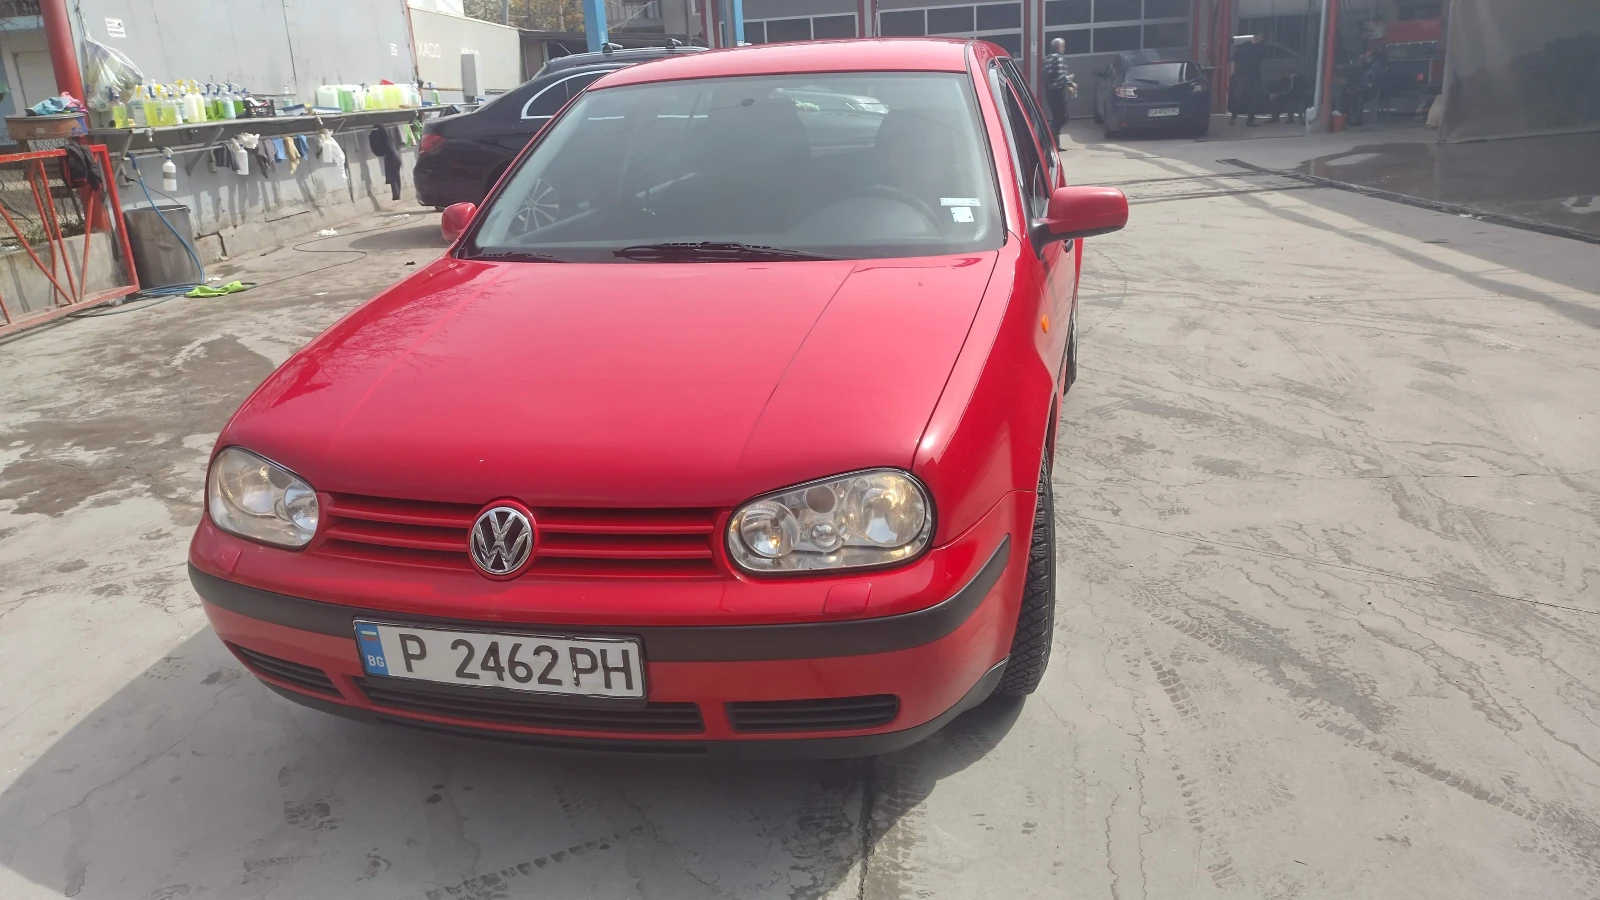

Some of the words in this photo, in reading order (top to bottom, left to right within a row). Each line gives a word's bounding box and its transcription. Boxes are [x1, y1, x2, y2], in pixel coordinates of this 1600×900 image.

[367, 654, 385, 668] BG
[399, 633, 427, 673] P
[450, 638, 563, 686] 2462
[568, 646, 634, 691] PH
